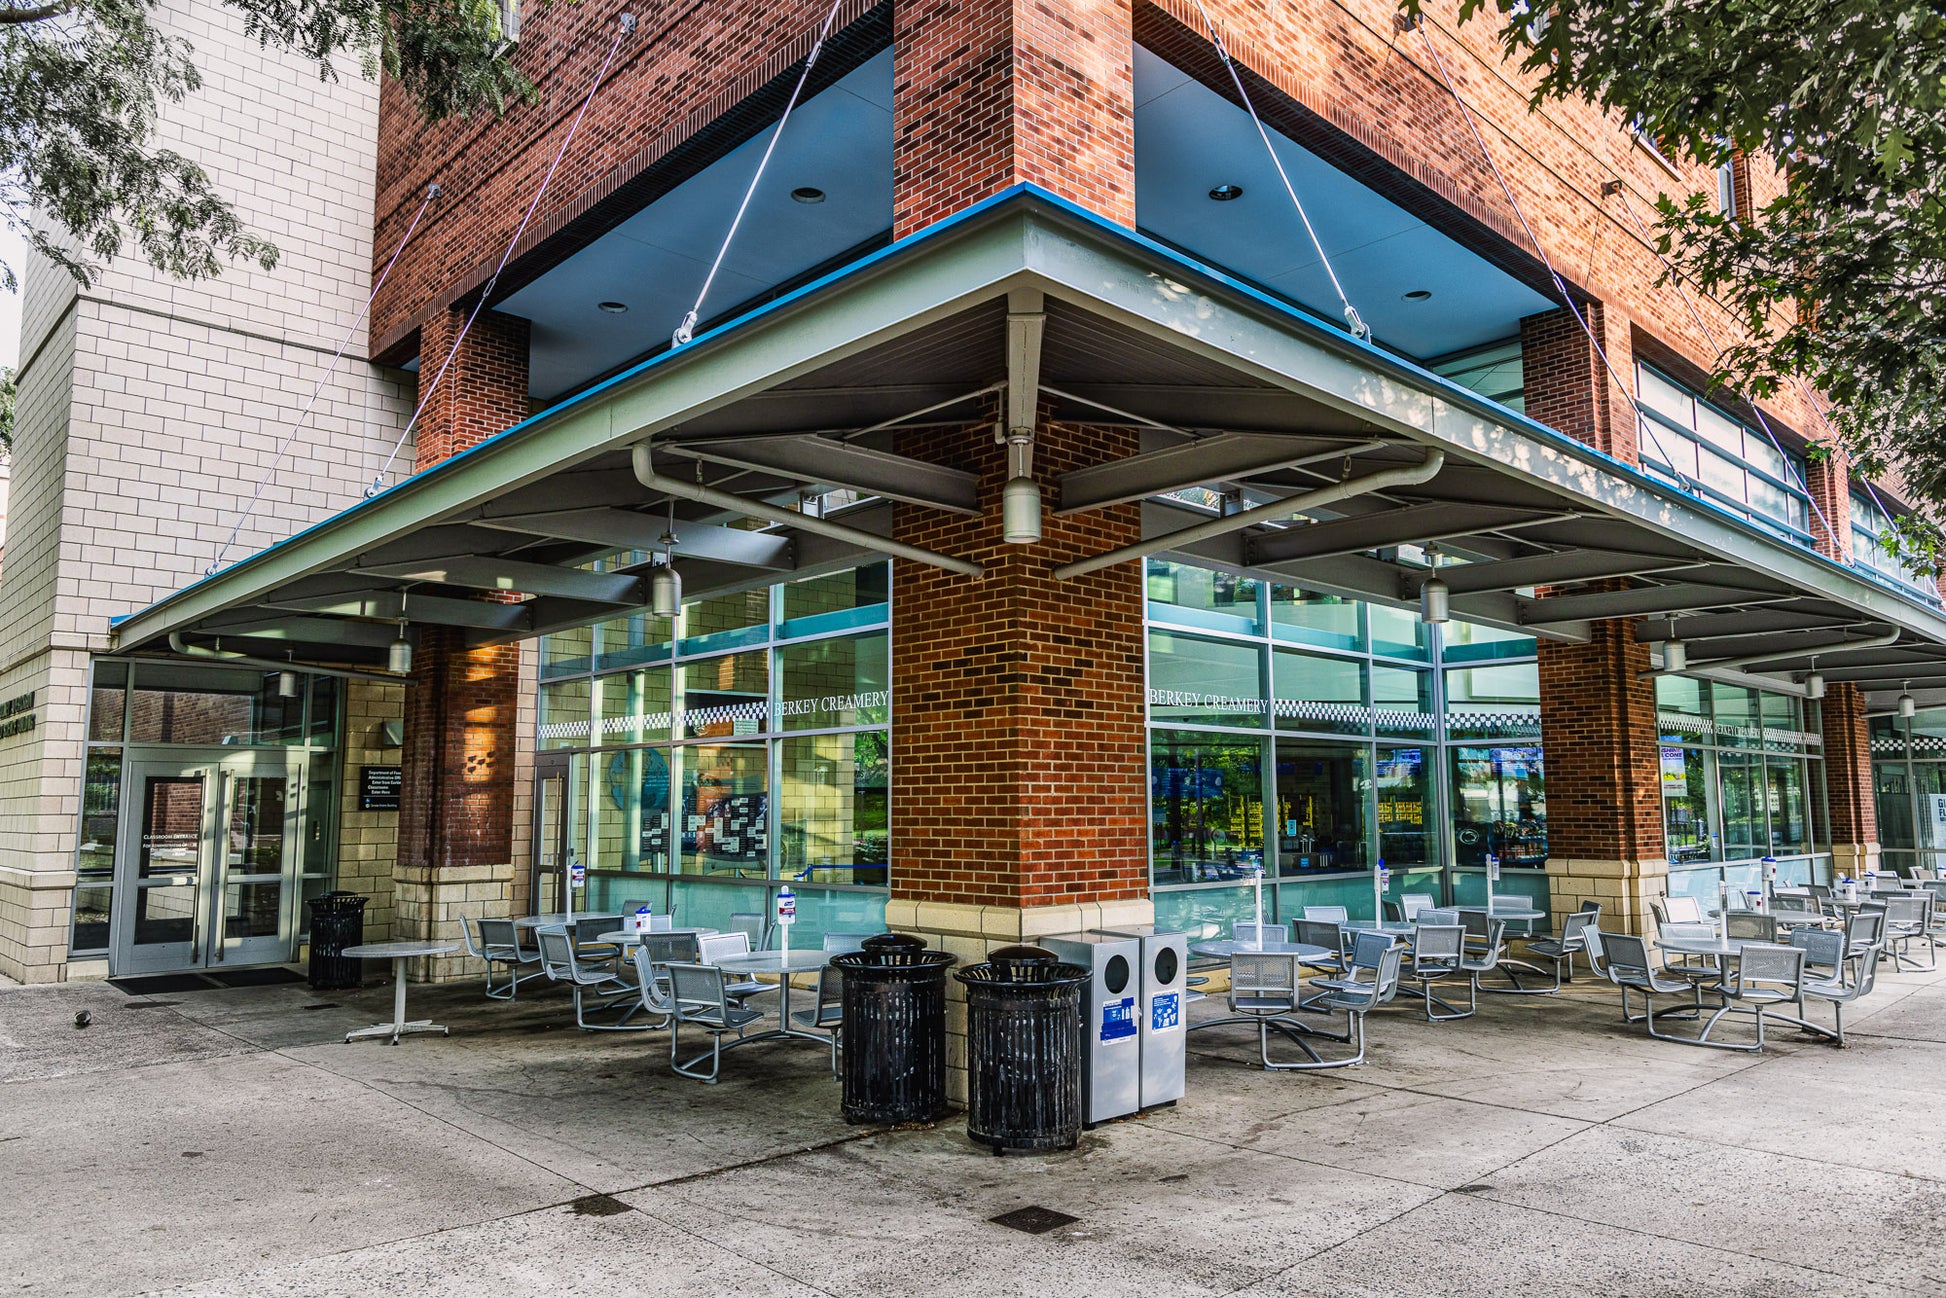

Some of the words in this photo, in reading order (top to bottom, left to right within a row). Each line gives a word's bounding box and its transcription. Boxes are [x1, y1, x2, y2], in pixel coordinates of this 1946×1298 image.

[774, 698, 818, 716] BERKEY
[821, 691, 888, 712] CREAMERY
[1149, 689, 1200, 707] BERKEY
[1204, 694, 1268, 713] CREAMERY
